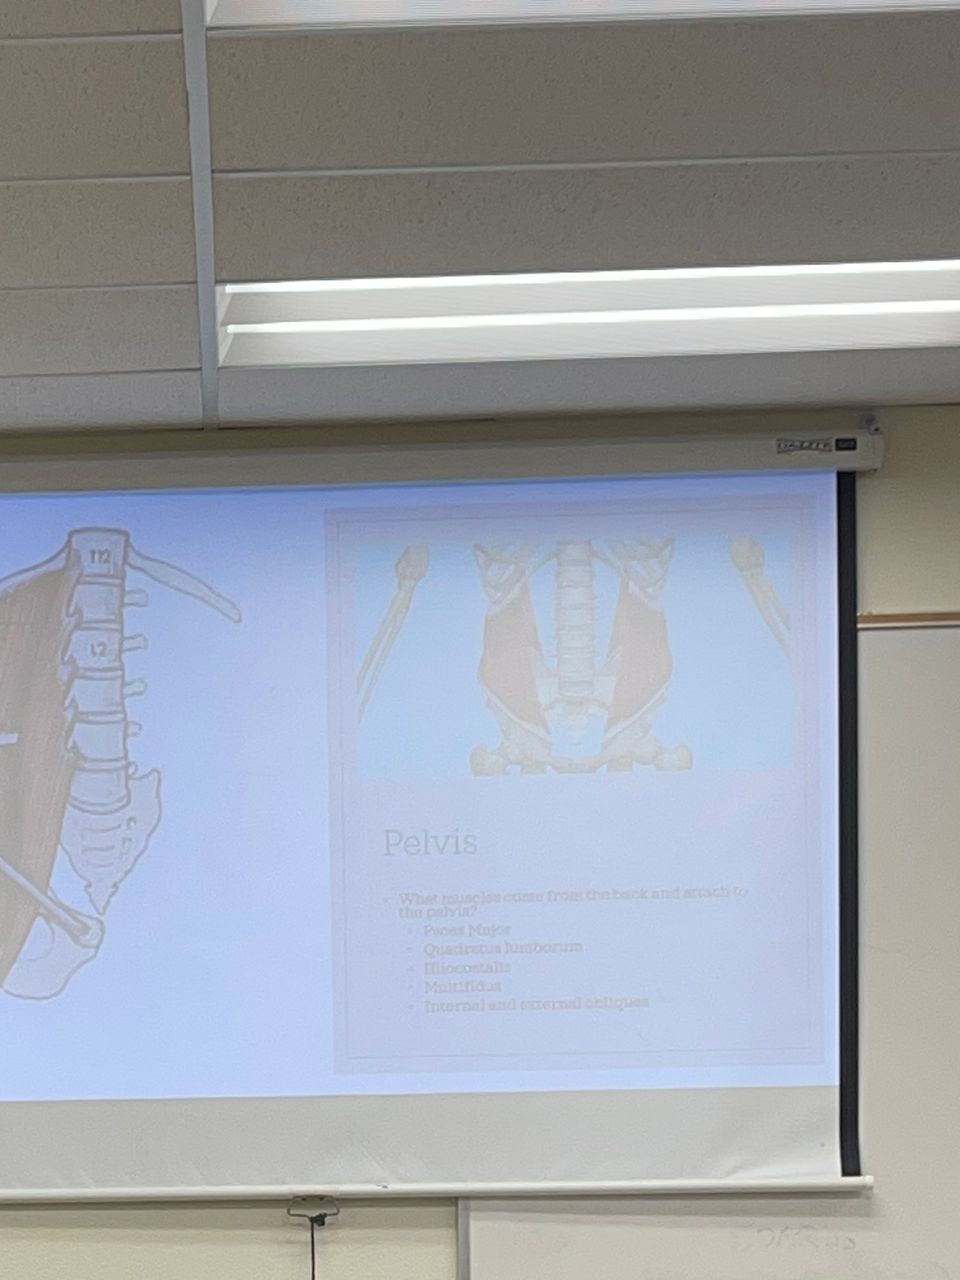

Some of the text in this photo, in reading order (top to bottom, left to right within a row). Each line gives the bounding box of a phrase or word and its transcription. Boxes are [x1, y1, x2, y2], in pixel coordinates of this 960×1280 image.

[384, 828, 478, 857] Pelvis
[399, 893, 437, 906] What
[442, 891, 501, 905] muscles
[547, 890, 584, 904] from
[586, 889, 610, 902] the
[612, 888, 648, 901] back
[652, 887, 680, 900] and
[684, 886, 730, 899] attach
[733, 886, 749, 898] to
[399, 904, 478, 922] the pelvis?
[468, 923, 513, 939] Major
[423, 940, 584, 958] Quadratus lumborum
[424, 979, 502, 994] Multifidus
[424, 996, 650, 1013] Internal and external obliques
